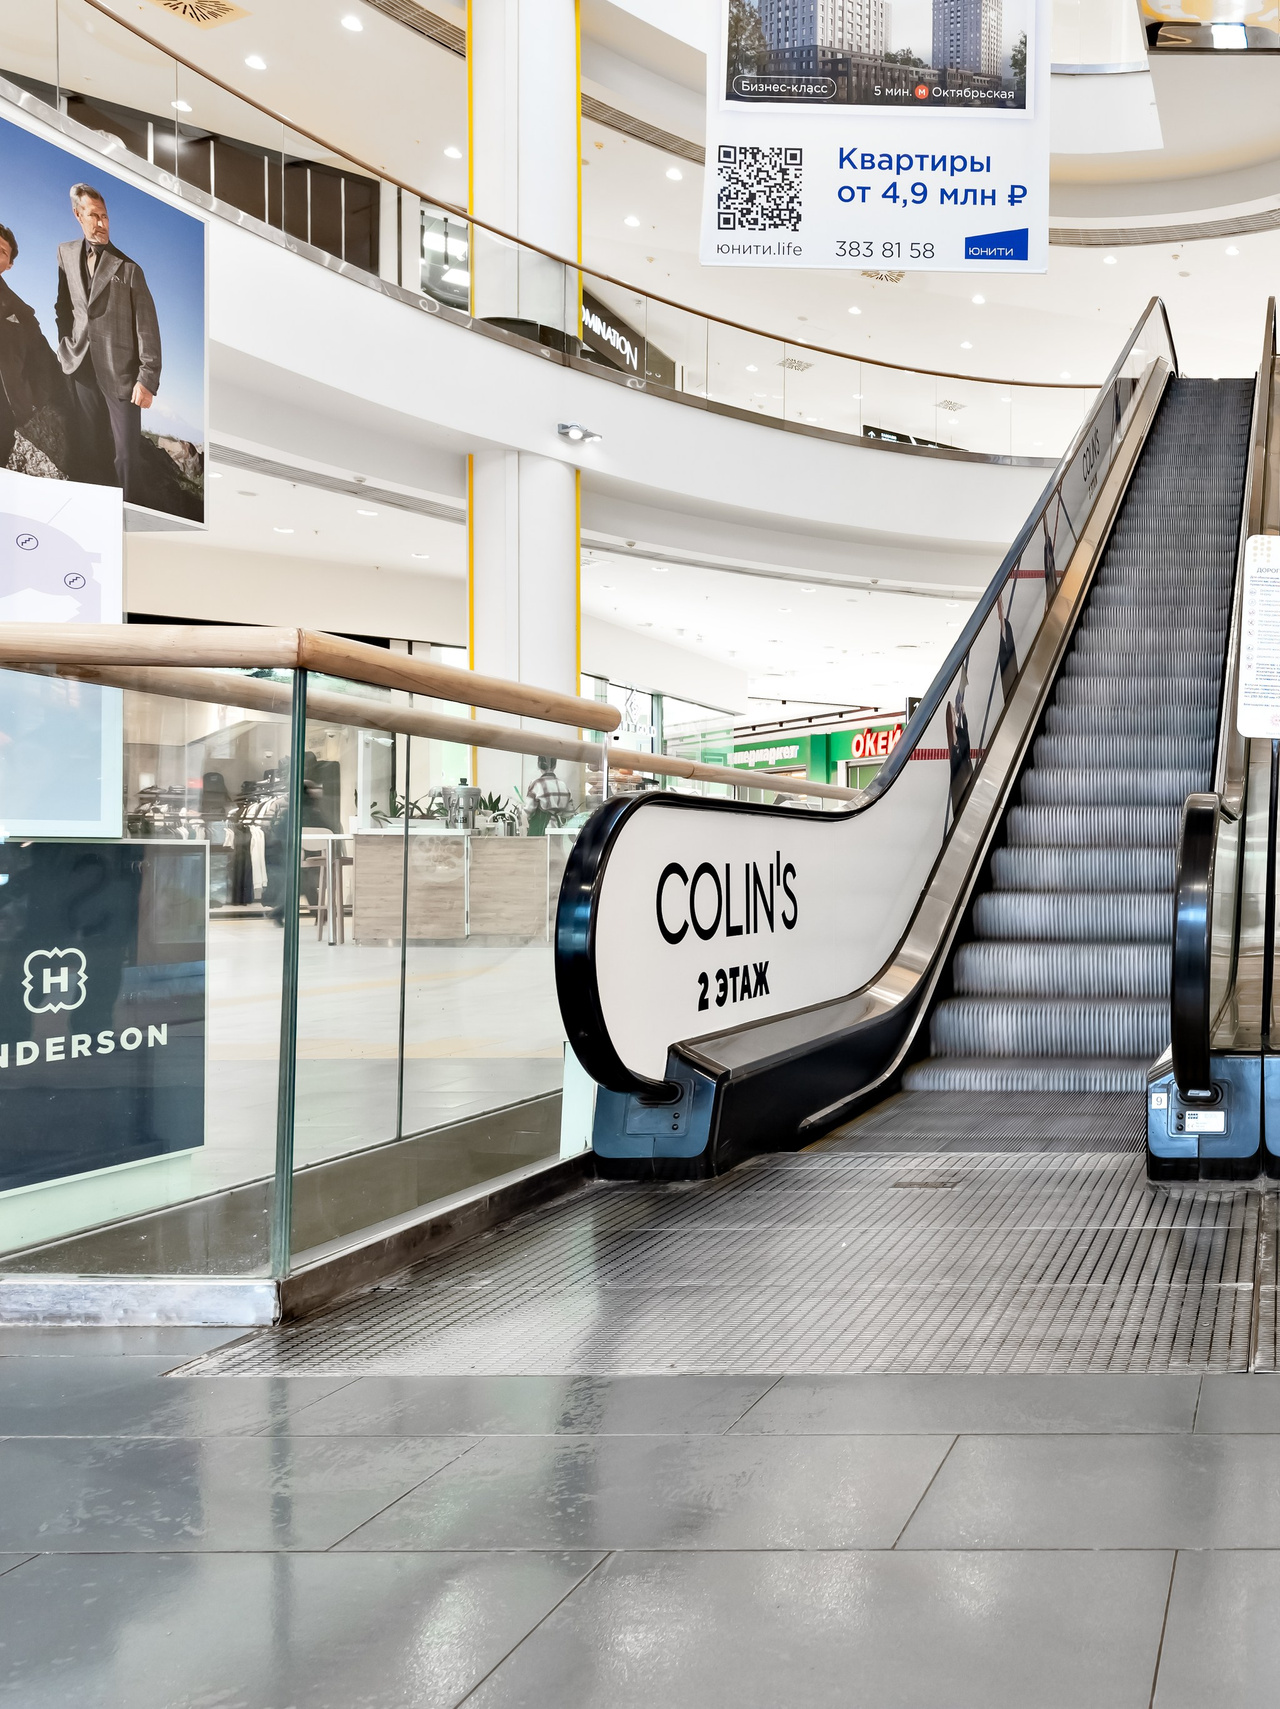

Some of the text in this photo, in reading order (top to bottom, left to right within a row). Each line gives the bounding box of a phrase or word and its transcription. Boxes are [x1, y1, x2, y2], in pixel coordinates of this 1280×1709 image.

[741, 80, 828, 94] Бизнес-класс
[874, 85, 882, 96] 5
[885, 87, 912, 97] мин.
[931, 86, 1015, 101] Октябрьская
[838, 147, 991, 177] Квартиры
[837, 184, 871, 204] от
[881, 182, 928, 208] 4,9
[940, 186, 996, 206] млн
[716, 241, 802, 257] юнити.life
[835, 240, 936, 259] 383 81 58
[656, 850, 798, 945] COLIN'S
[697, 961, 770, 1012] 2 ЭТАЖ
[1155, 1096, 1163, 1107] 9
